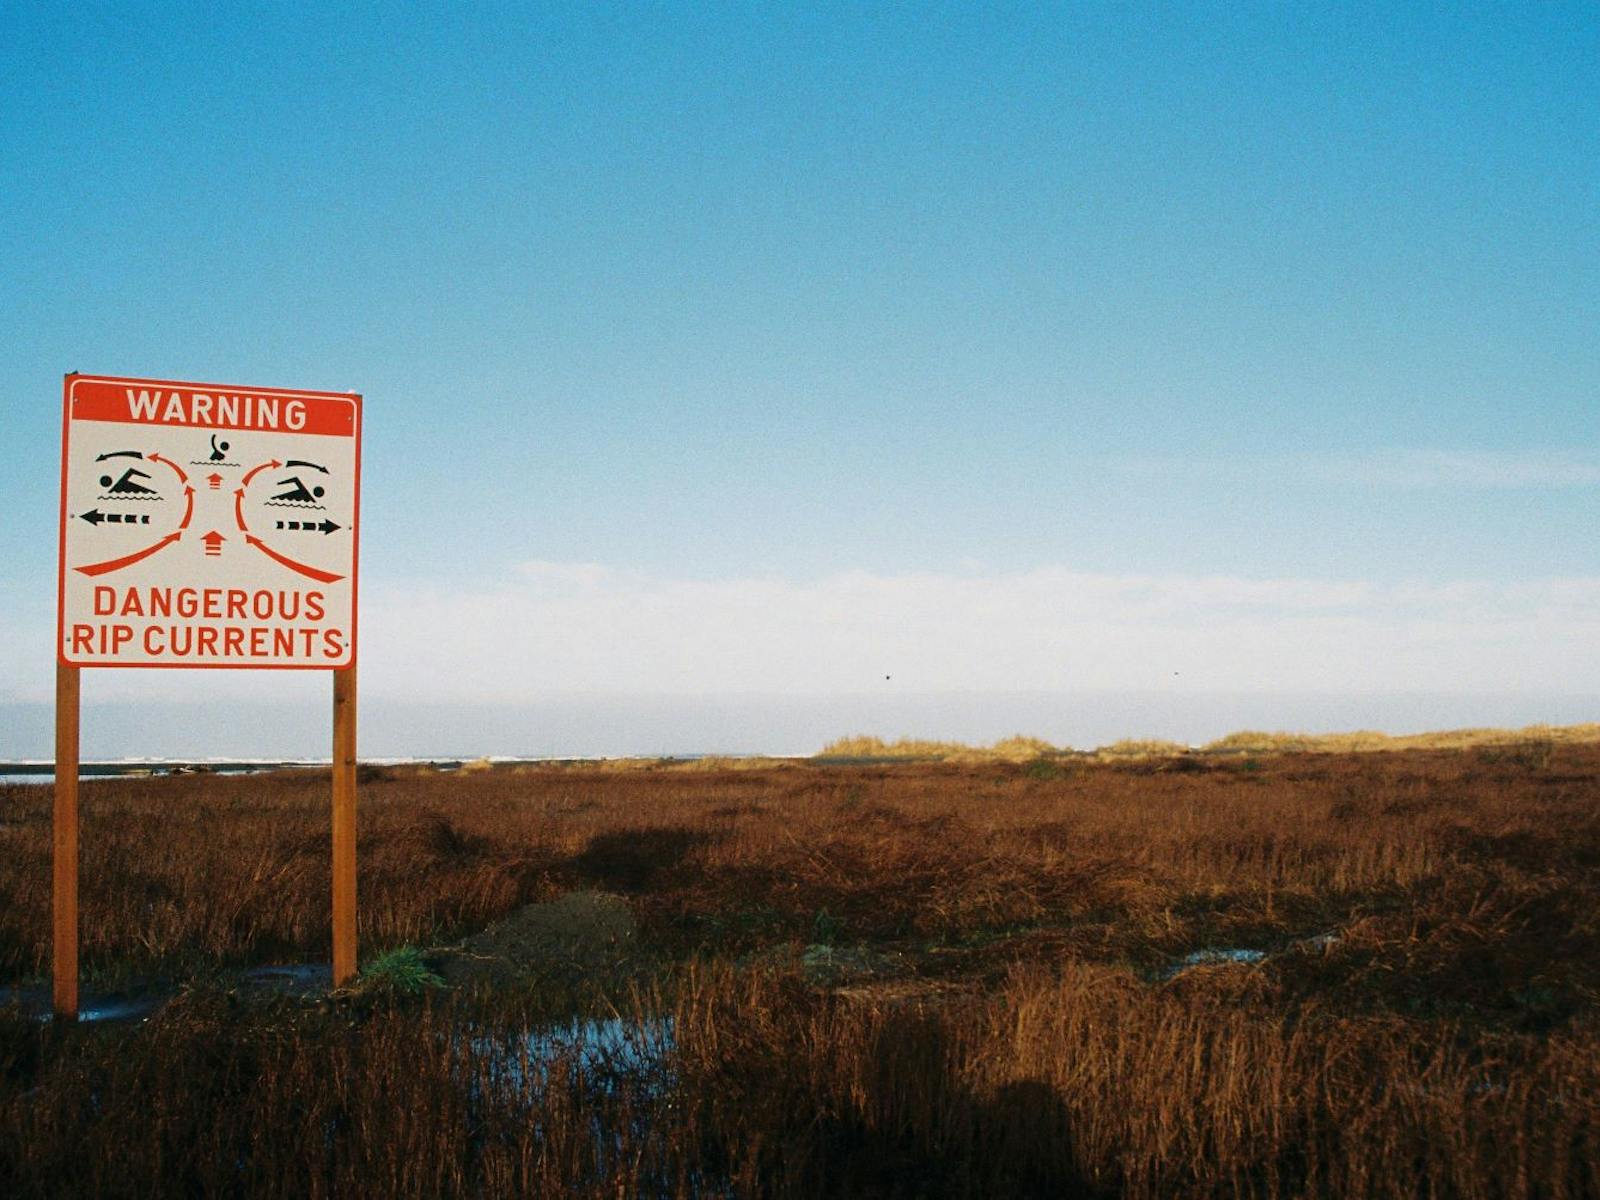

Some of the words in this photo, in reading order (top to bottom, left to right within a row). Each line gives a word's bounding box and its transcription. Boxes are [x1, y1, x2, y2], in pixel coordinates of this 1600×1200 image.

[126, 389, 307, 430] WARNING
[93, 585, 325, 622] DANGEROUS
[72, 623, 134, 655] RIP
[143, 625, 344, 659] CURRENTS
